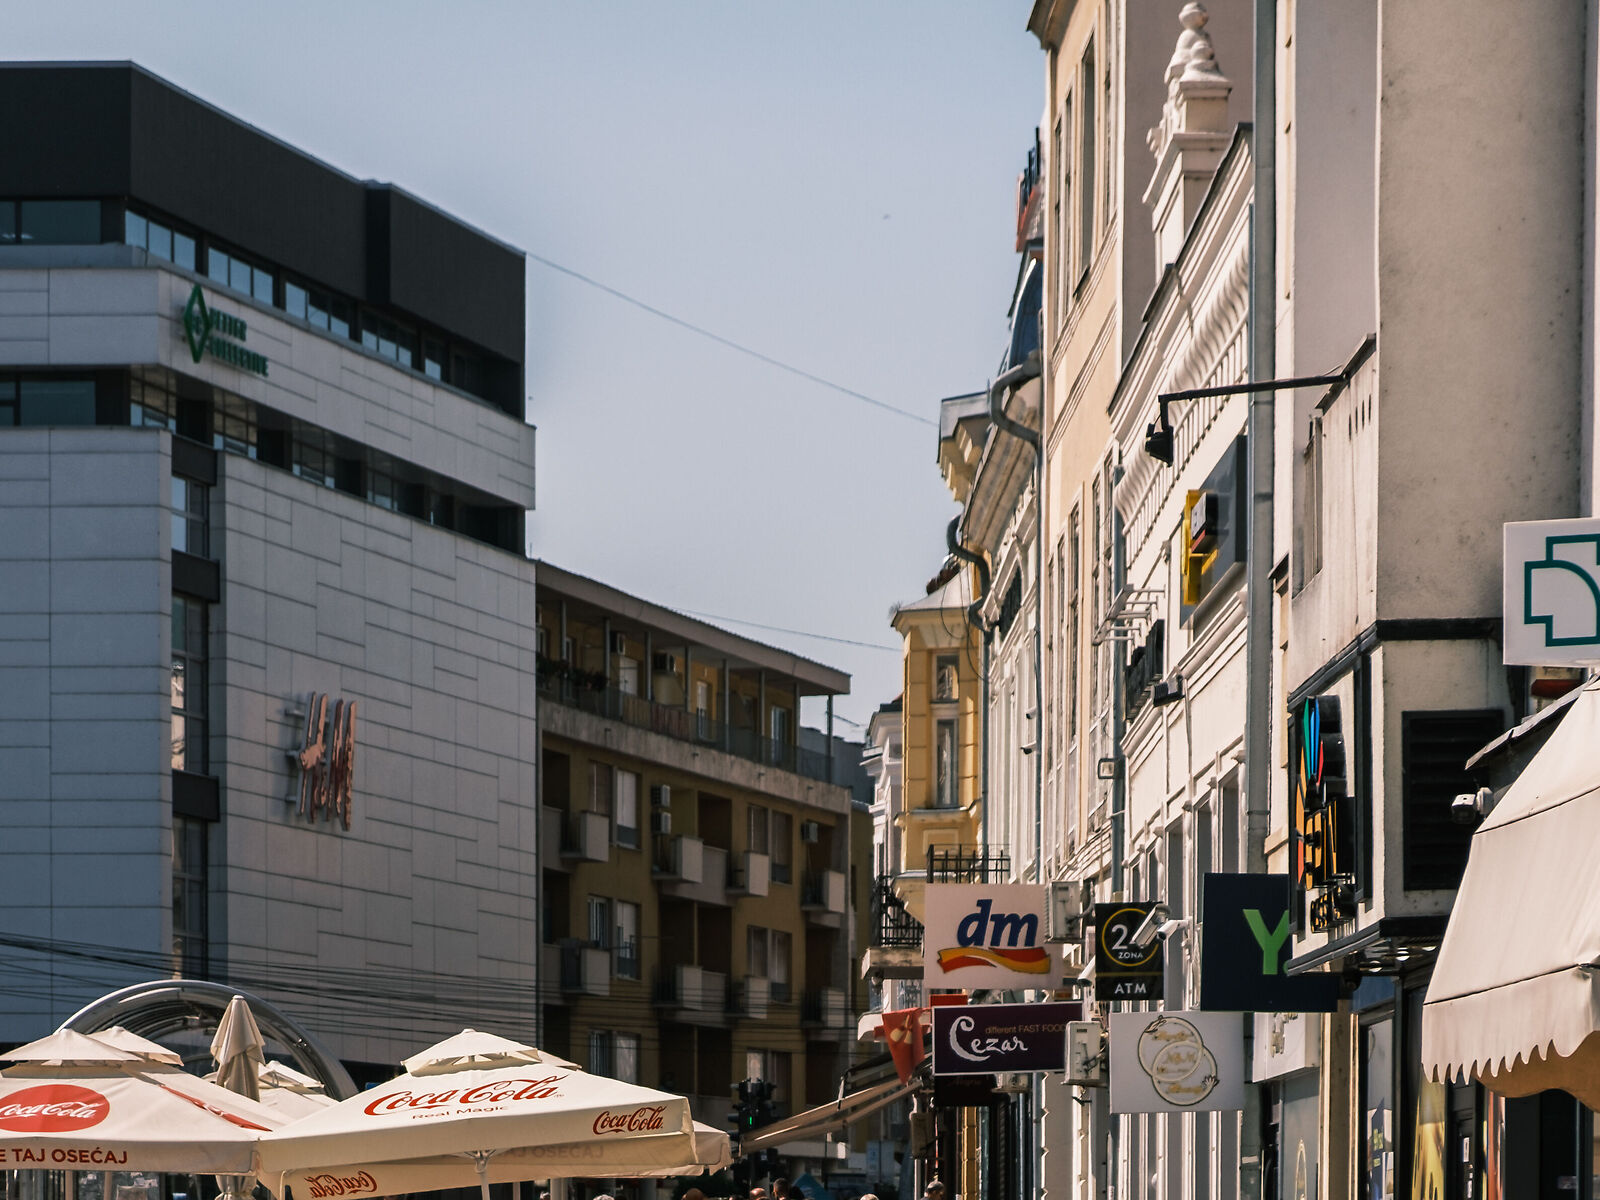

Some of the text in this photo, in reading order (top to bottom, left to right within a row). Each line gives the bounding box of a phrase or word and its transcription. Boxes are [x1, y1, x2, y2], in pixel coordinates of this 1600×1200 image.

[957, 899, 1038, 947] dm
[1243, 909, 1290, 975] Y
[1118, 951, 1143, 960] ZONA
[1114, 983, 1147, 994] ATM
[950, 1016, 1028, 1061] Cezar
[1018, 1025, 1040, 1034] FAST
[364, 1074, 568, 1115] Coca-Cola
[412, 1105, 510, 1120] Real Magic
[593, 1106, 667, 1135] Coca-Cola
[12, 1148, 45, 1162] TAJ
[52, 1146, 127, 1164] OSEĆAJ
